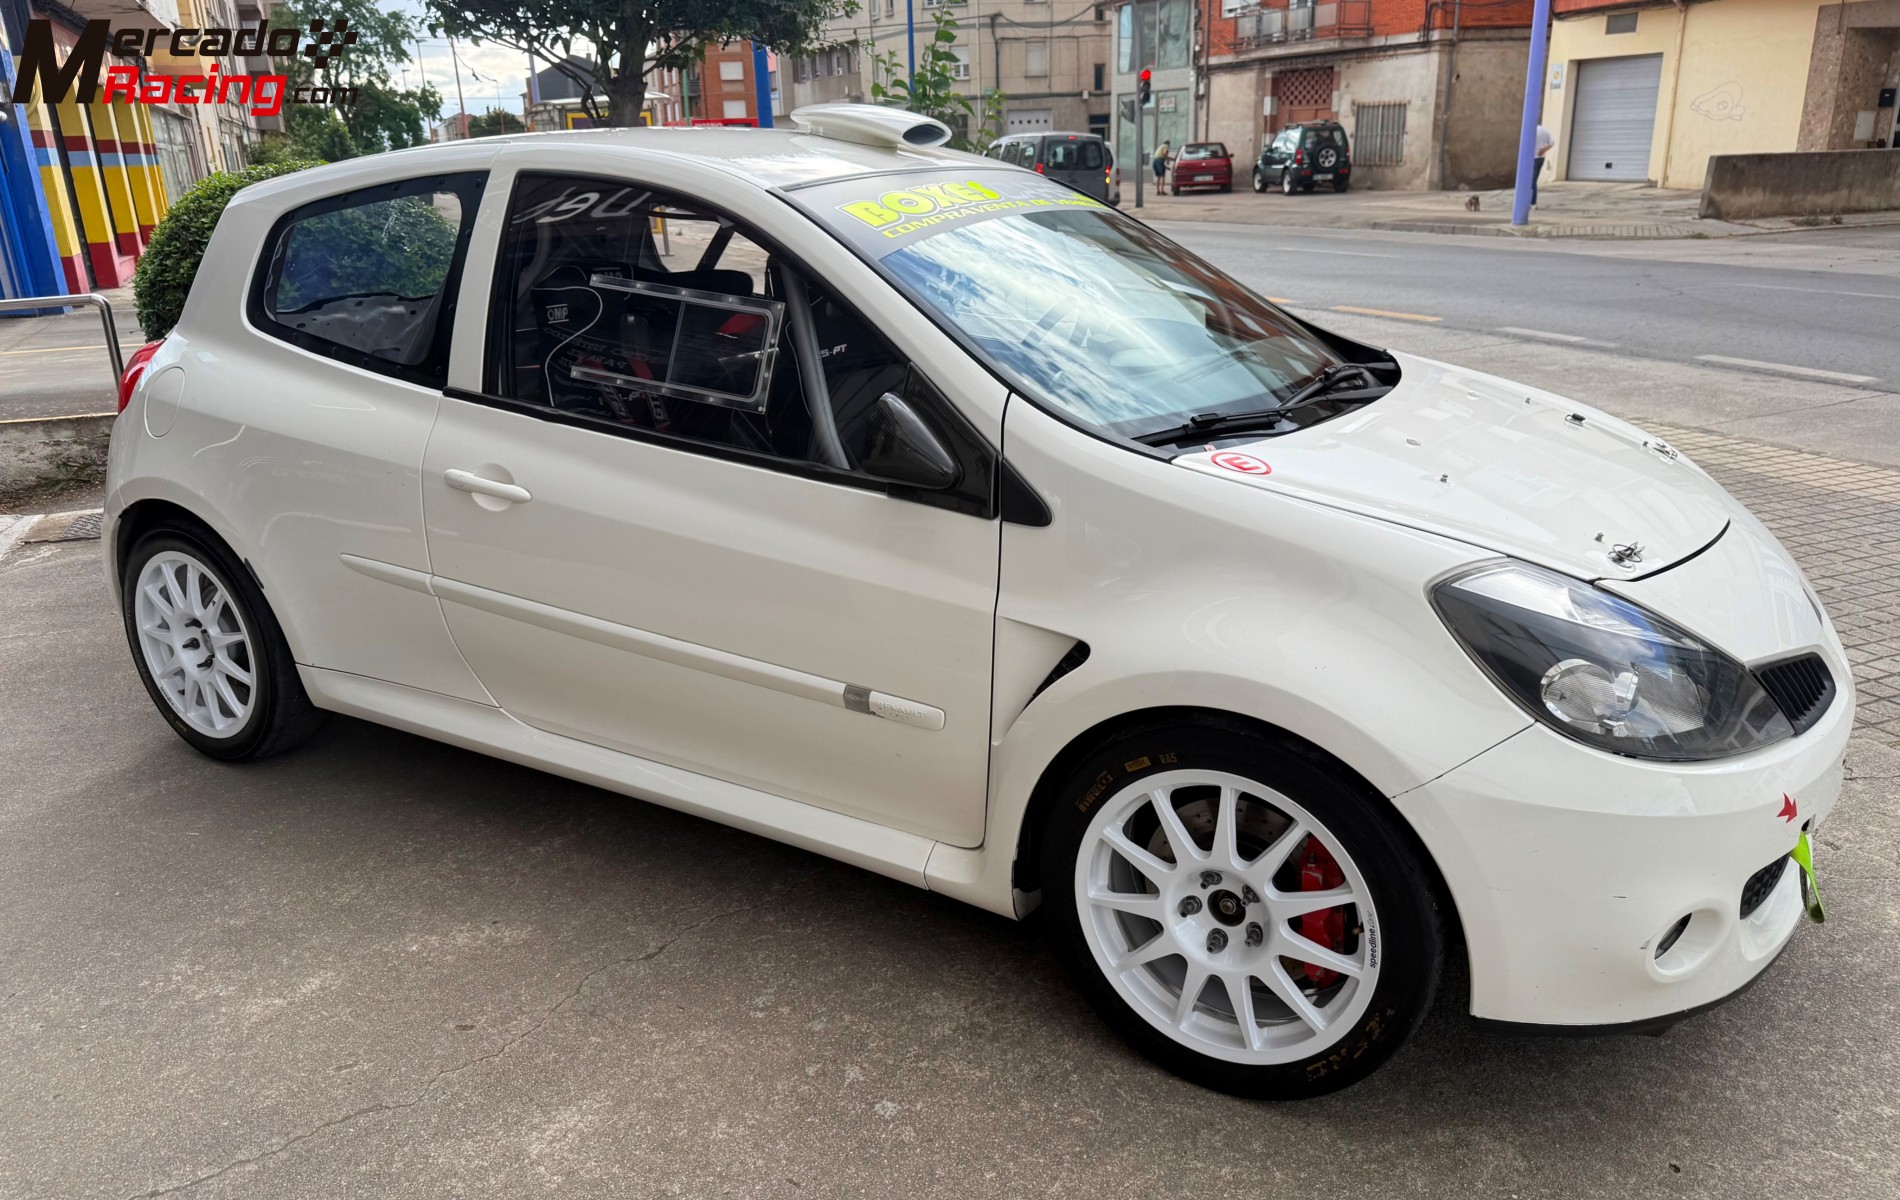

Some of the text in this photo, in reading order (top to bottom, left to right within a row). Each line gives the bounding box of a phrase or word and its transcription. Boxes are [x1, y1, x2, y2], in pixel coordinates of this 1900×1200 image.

[840, 181, 1000, 228] BOXES
[882, 198, 1031, 239] COMPRAVENTA
[547, 307, 569, 321] OMP
[876, 699, 927, 720] RENAULT
[1368, 928, 1378, 969] speedline
